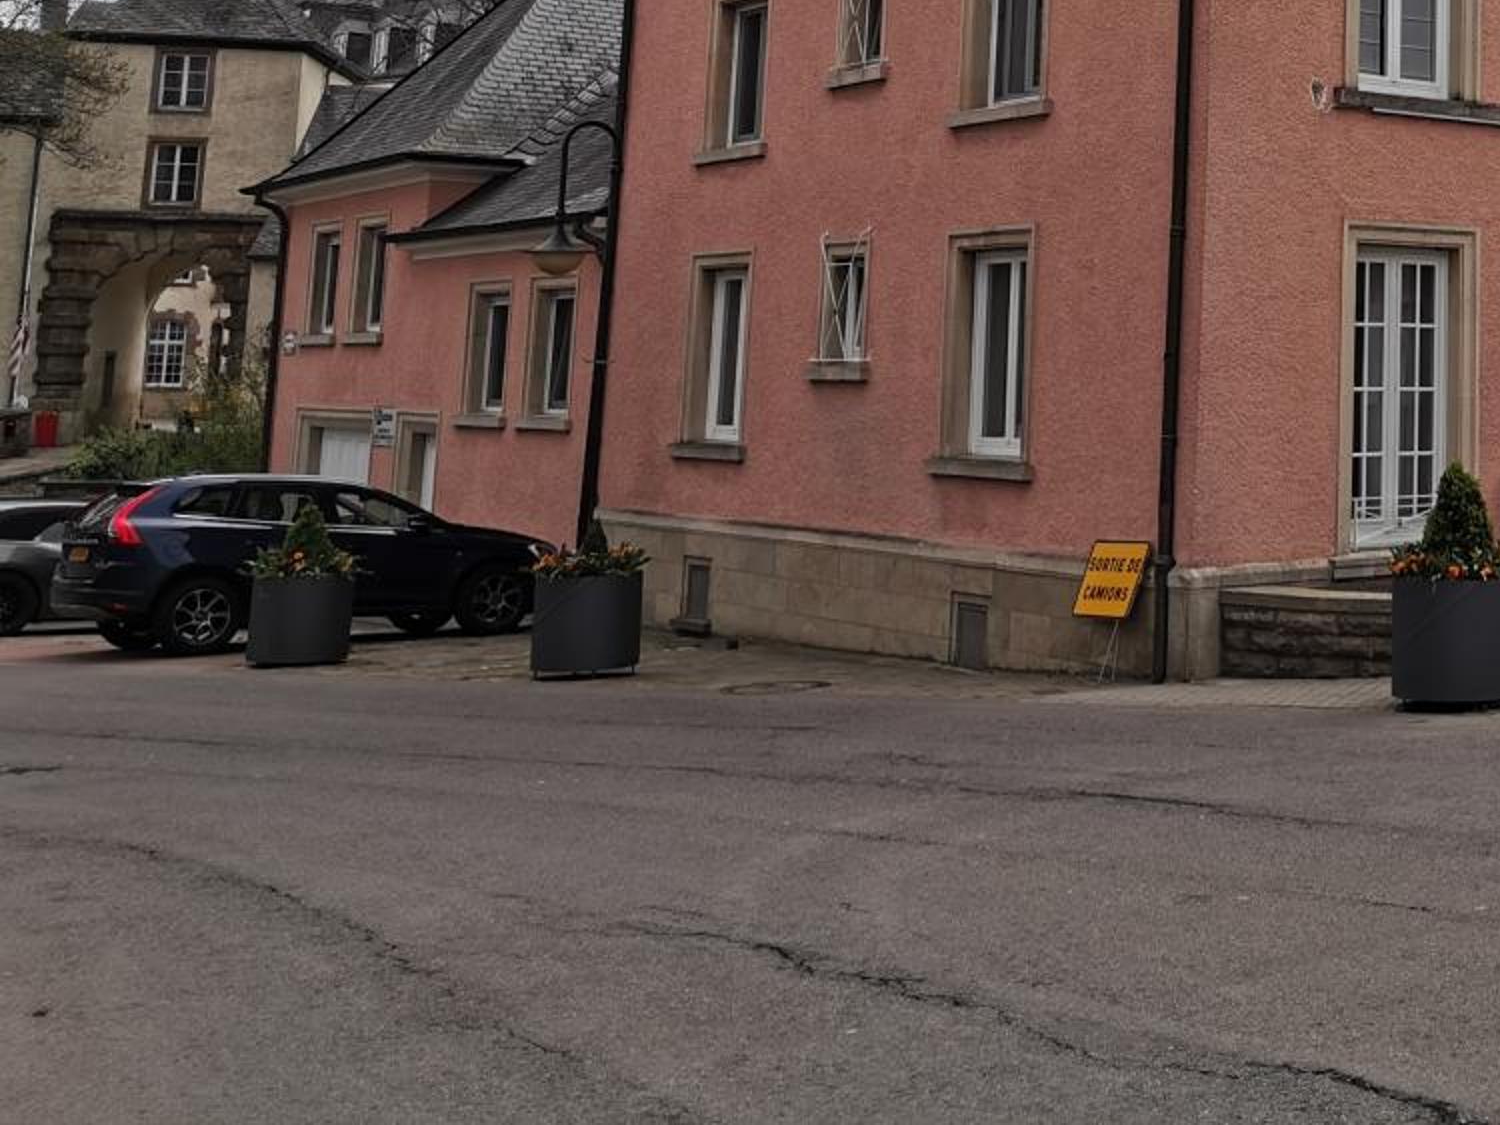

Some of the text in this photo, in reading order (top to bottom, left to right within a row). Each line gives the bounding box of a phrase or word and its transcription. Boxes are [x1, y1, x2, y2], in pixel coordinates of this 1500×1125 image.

[1089, 556, 1142, 573] SORTIE DE
[1082, 586, 1129, 602] CAMIONS
